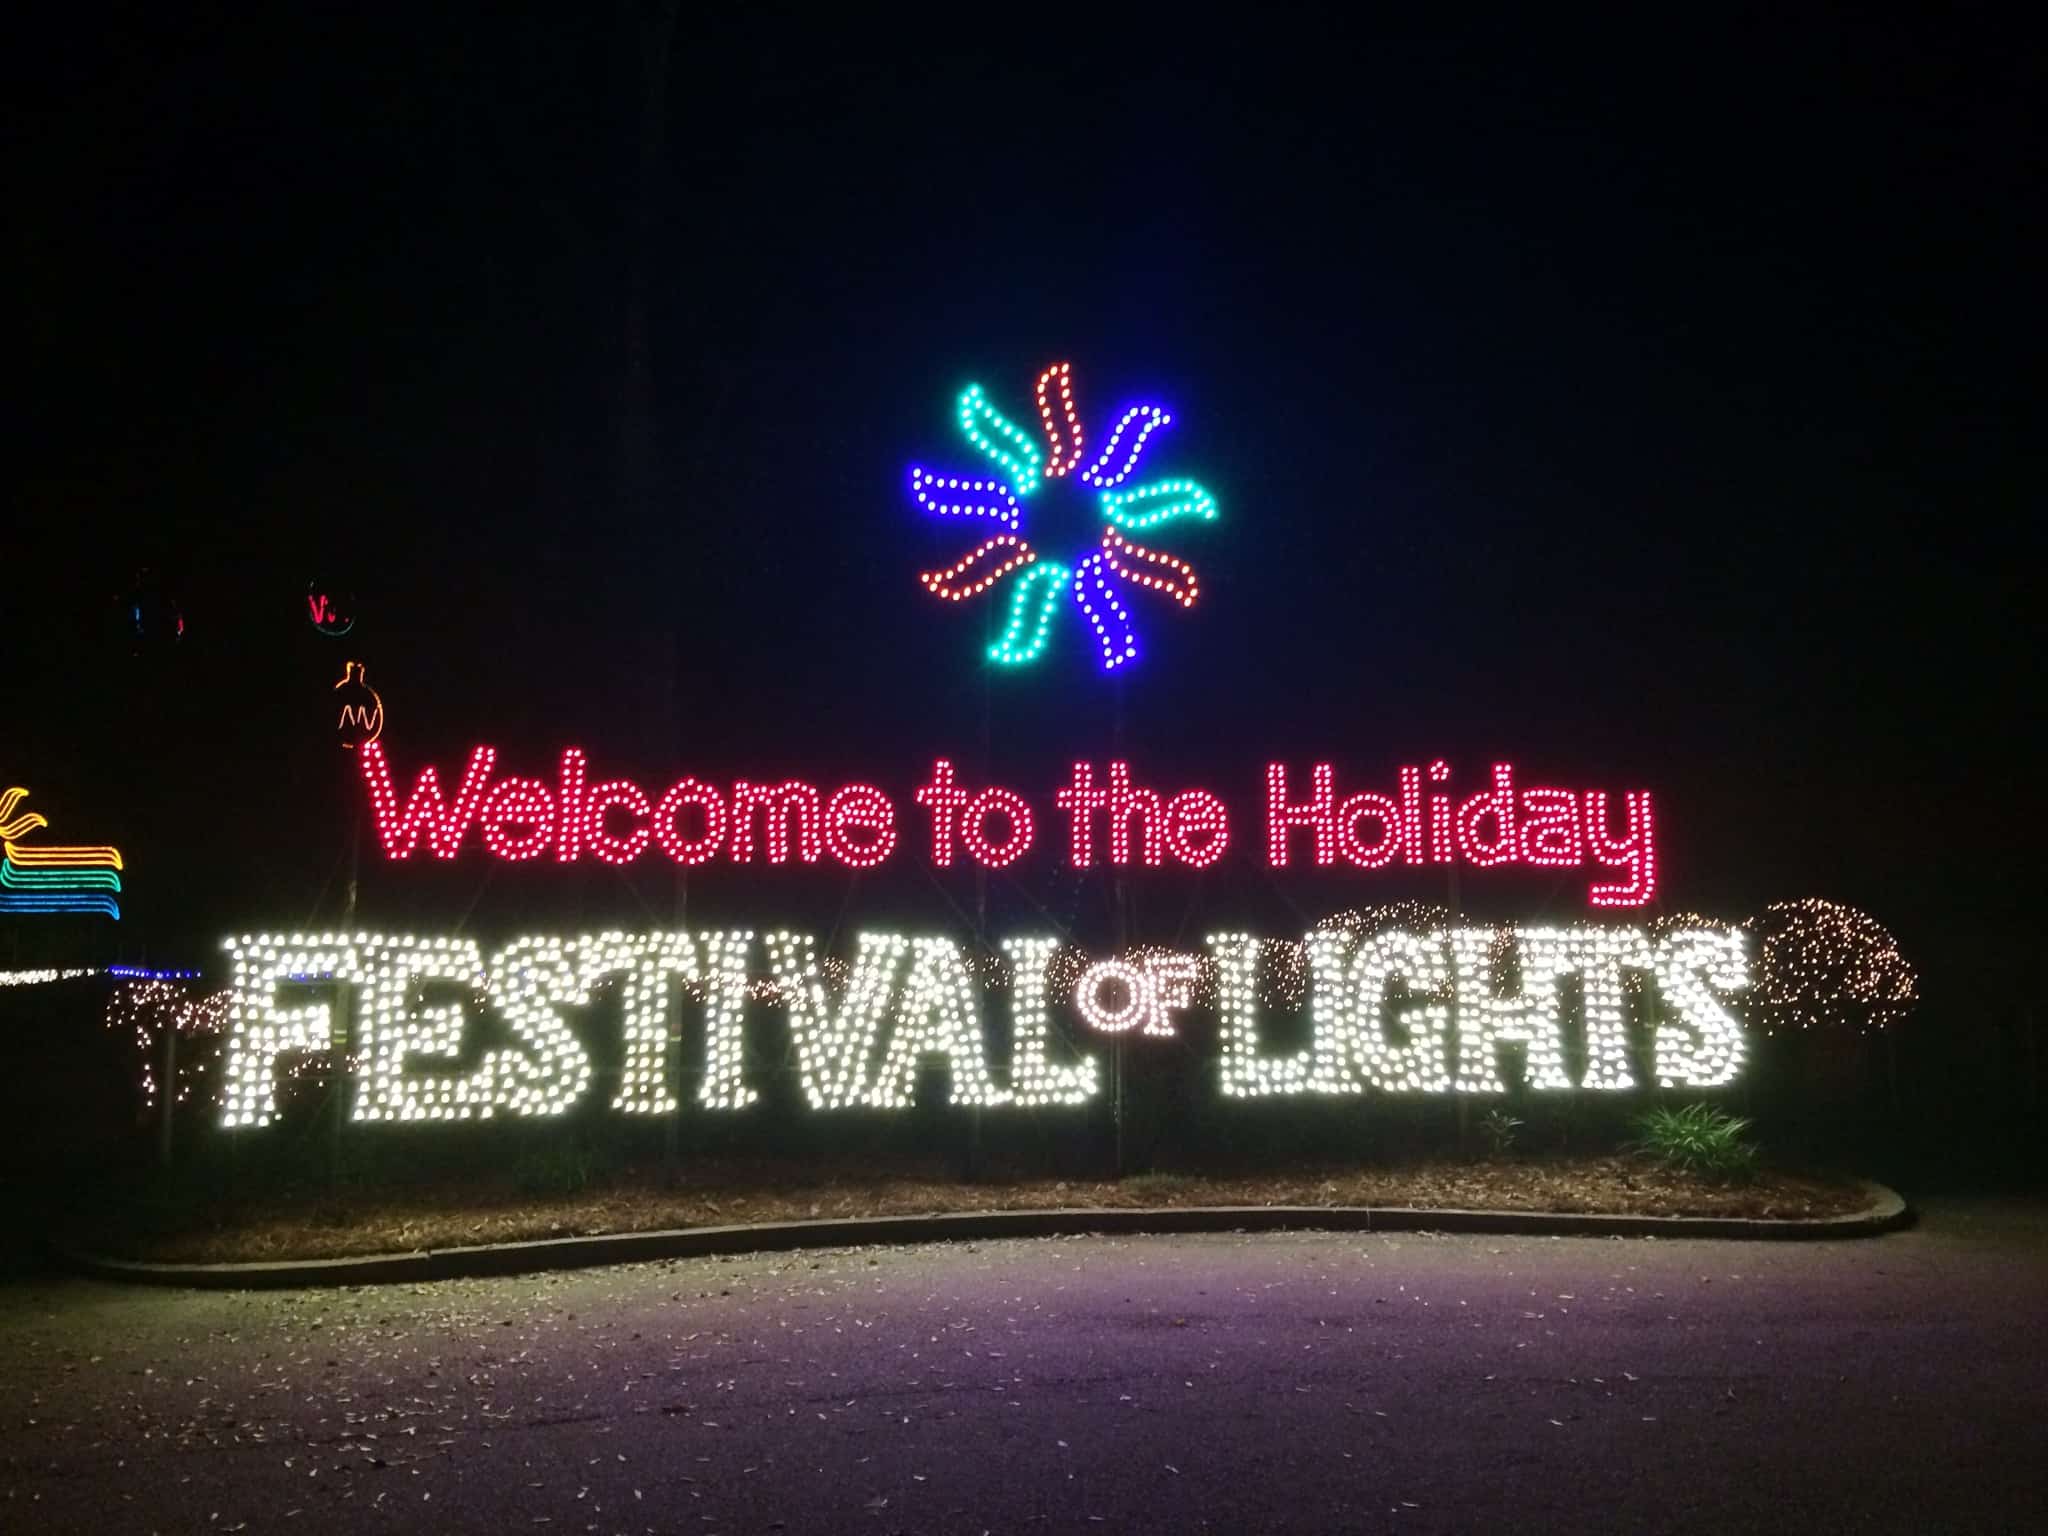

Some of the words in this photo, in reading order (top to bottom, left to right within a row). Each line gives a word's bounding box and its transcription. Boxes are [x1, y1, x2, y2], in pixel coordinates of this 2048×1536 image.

[361, 740, 898, 868] Welcome
[915, 758, 1035, 868] to
[1056, 759, 1231, 869] the
[1265, 760, 1656, 907] Holiday
[219, 928, 1100, 1130] FESTIVAL
[1075, 957, 1199, 1038] OF
[1205, 926, 1749, 1097] LIGHTS
